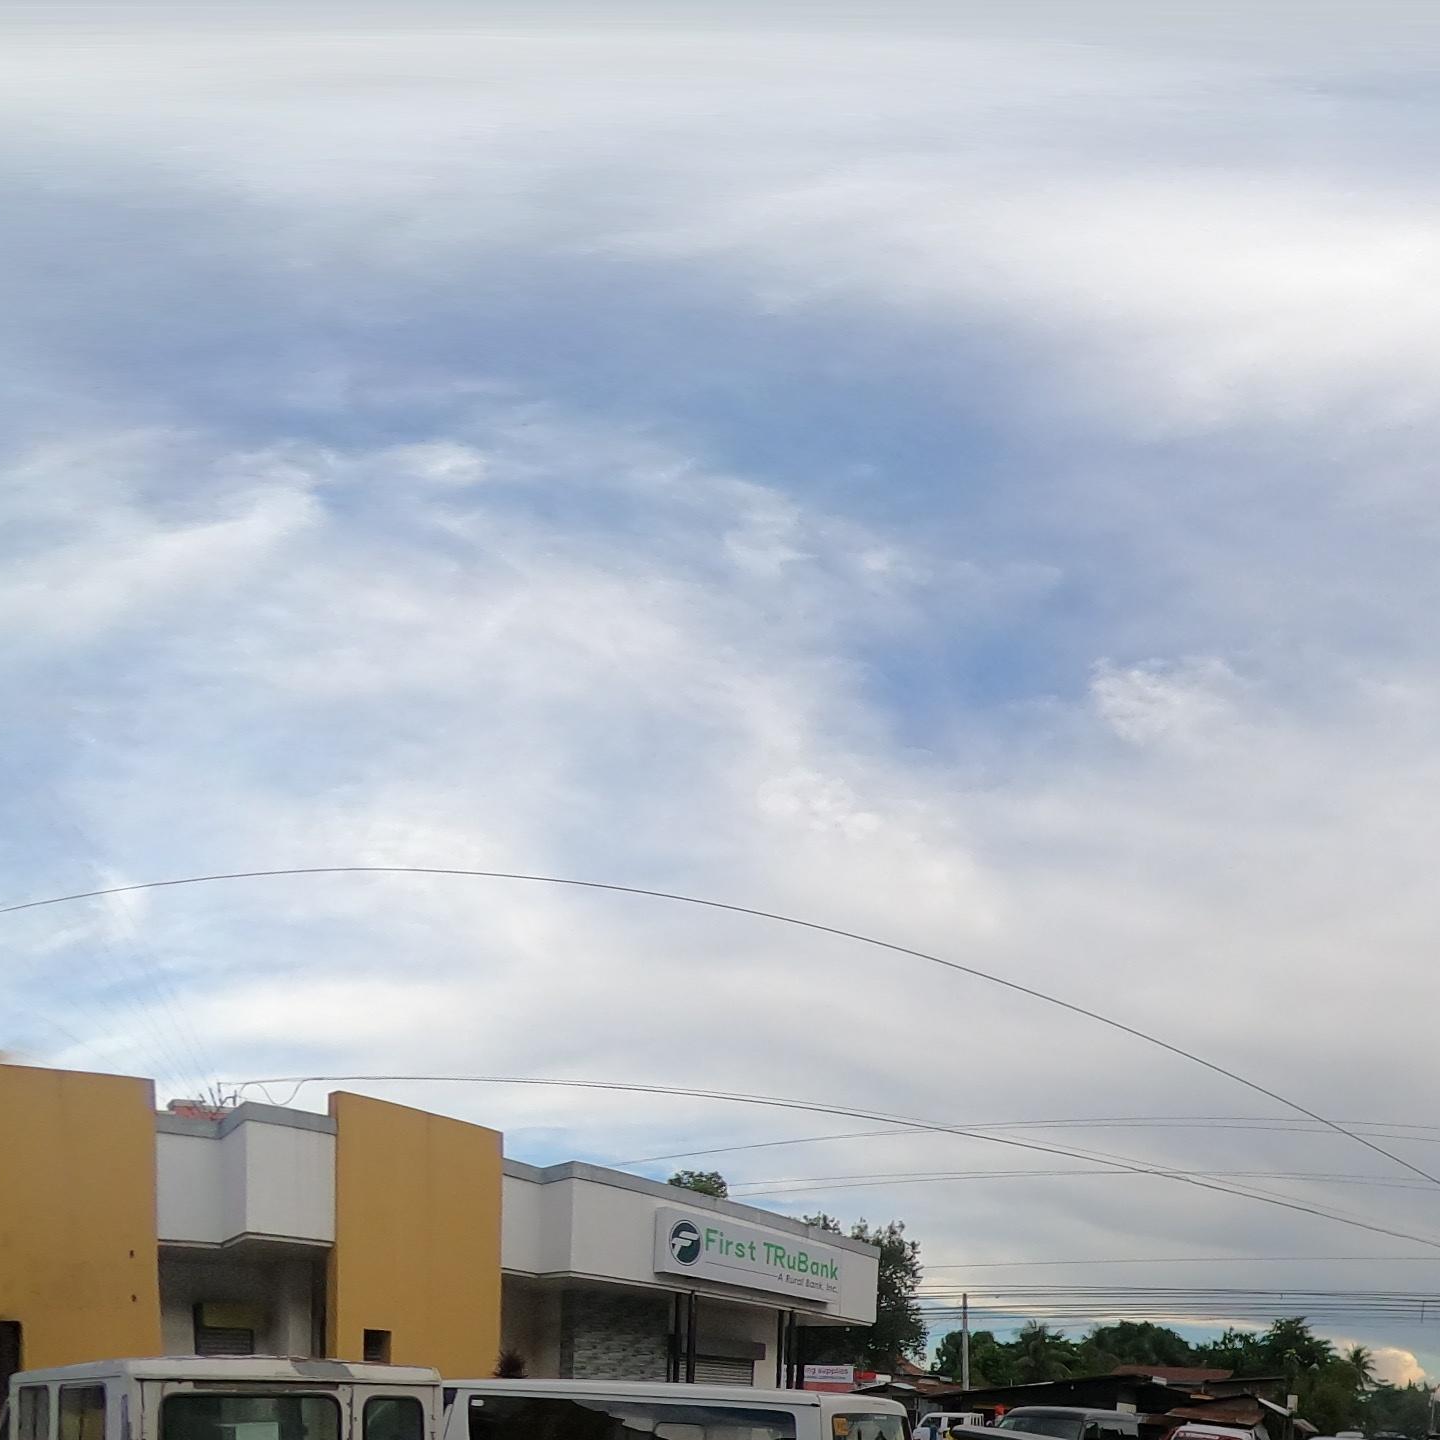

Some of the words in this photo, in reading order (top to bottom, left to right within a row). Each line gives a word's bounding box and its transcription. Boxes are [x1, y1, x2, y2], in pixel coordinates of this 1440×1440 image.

[704, 1227, 757, 1261] First
[763, 1242, 839, 1281] TRuBank
[777, 1273, 784, 1281] A
[785, 1274, 804, 1286] Rural
